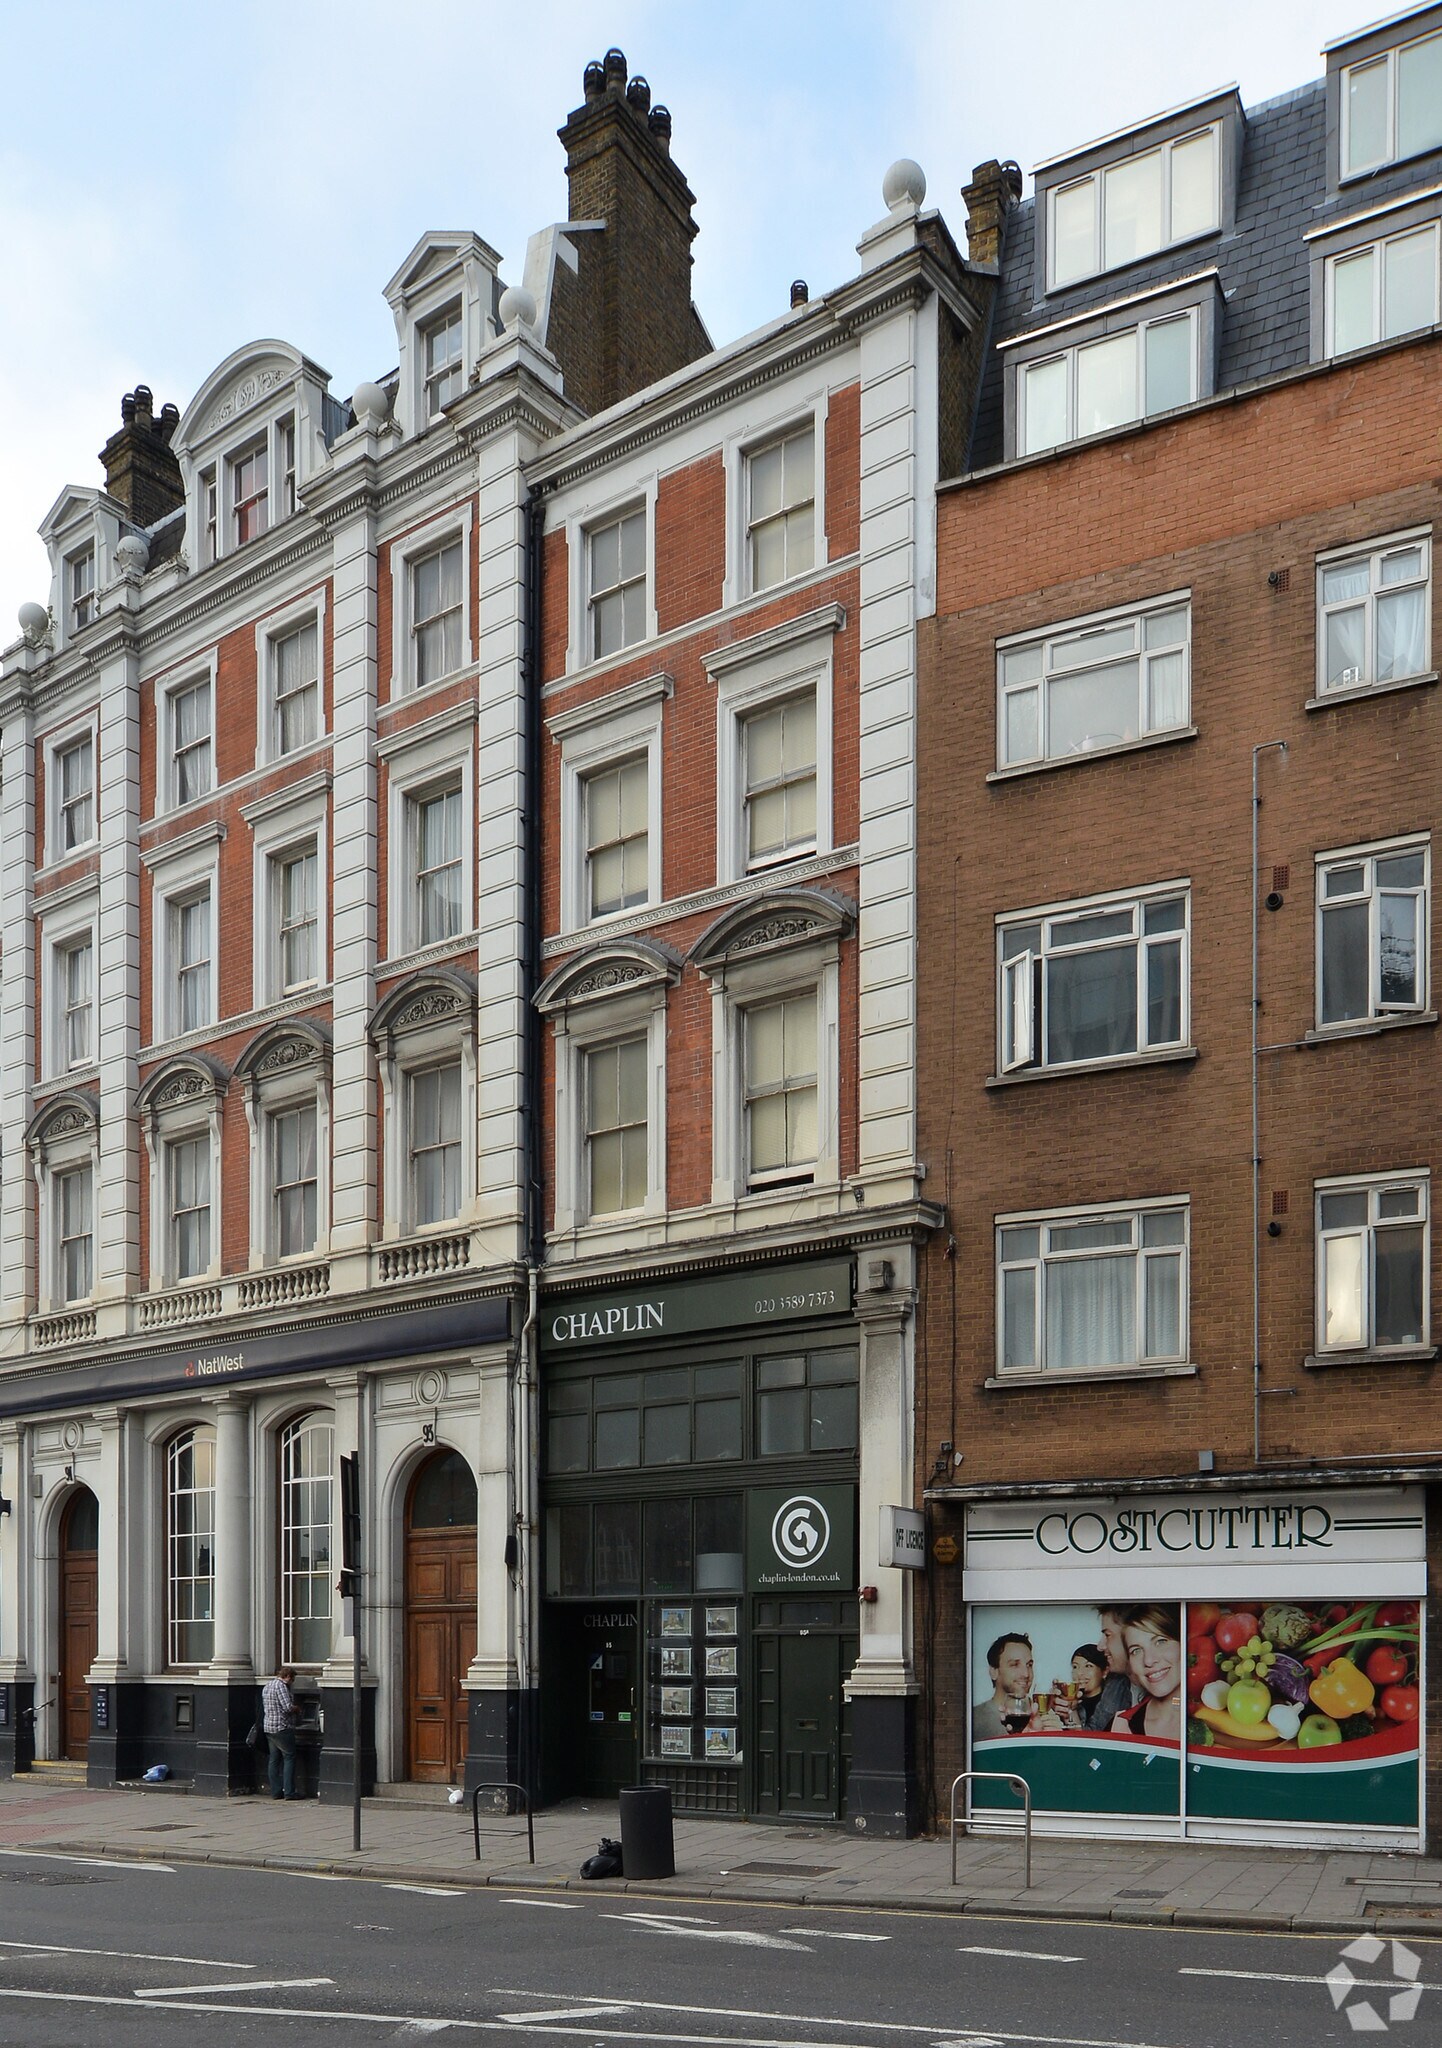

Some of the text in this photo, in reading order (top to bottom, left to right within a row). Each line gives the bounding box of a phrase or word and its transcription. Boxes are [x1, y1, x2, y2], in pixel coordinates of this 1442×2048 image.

[755, 1290, 835, 1314] 020 3589 7373
[552, 1301, 665, 1341] CHAPLIN
[197, 1353, 244, 1376] NatWest
[422, 1423, 434, 1443] 93
[896, 1528, 924, 1550] OFF LICENCE
[1036, 1504, 1333, 1555] COSTCUTTER
[758, 1571, 841, 1584] chaplin-london.co.uk
[583, 1613, 638, 1628] CHAPLIN
